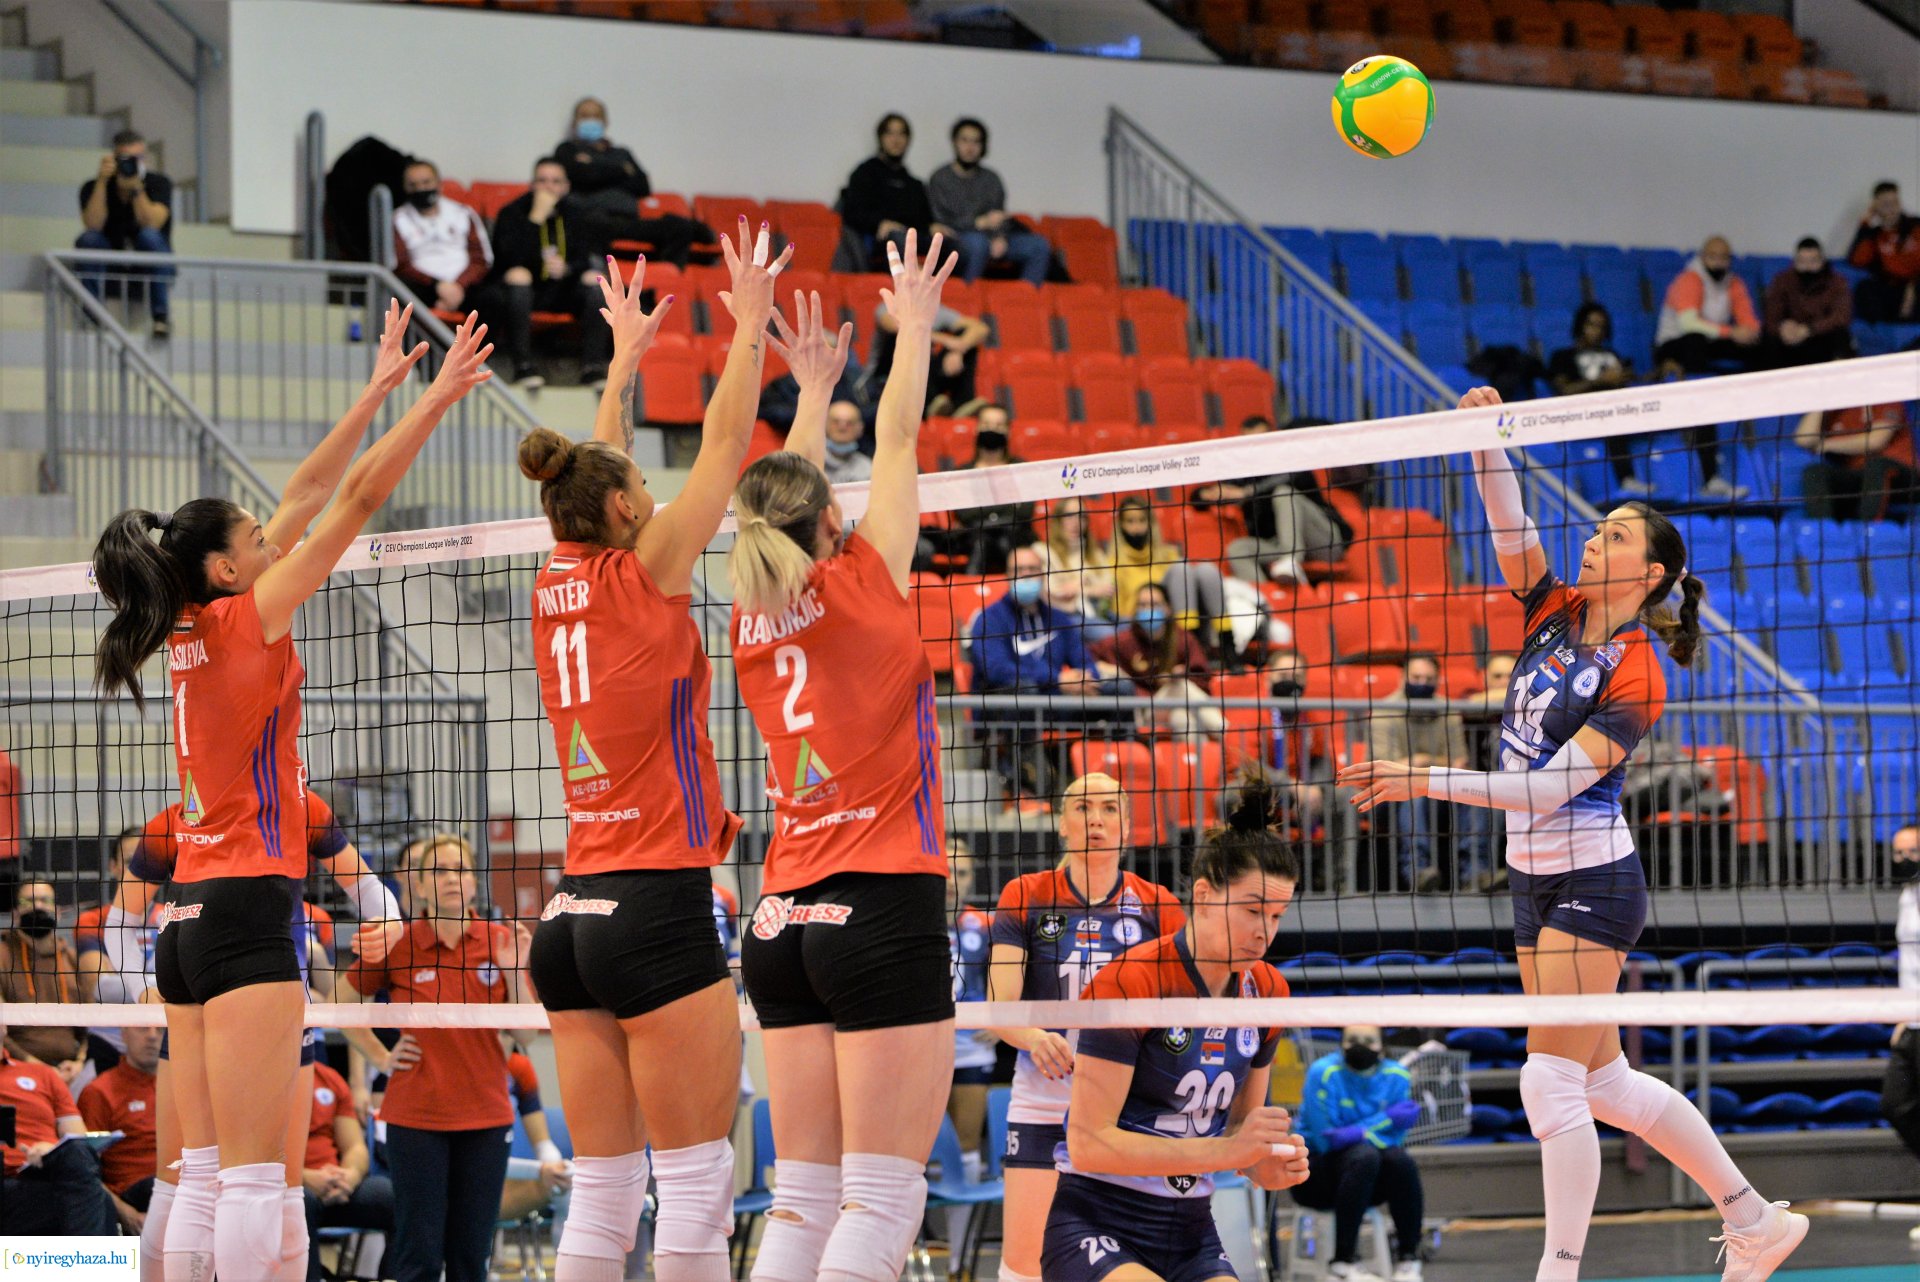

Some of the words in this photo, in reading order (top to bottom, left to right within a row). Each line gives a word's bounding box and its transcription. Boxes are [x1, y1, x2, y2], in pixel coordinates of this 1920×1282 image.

[1521, 416, 1538, 428] CEV
[1539, 411, 1583, 427] Champions
[1585, 408, 1614, 422] League
[1616, 404, 1640, 418] Volley
[1641, 401, 1661, 413] 2022
[1082, 468, 1097, 479] CEV
[1098, 464, 1135, 478] Champions
[1136, 463, 1161, 475] League
[1162, 458, 1183, 471] Volley
[1184, 456, 1201, 468] 2022
[385, 542, 397, 553] CEV
[397, 541, 424, 552] Champions
[424, 540, 444, 551] League
[444, 538, 460, 548] Volley
[460, 535, 473, 546] 2022
[536, 577, 590, 618] PINTÉR
[169, 639, 209, 671] ASILEVA
[551, 620, 591, 708] 11
[774, 644, 815, 733] 2
[175, 681, 190, 757] 1
[599, 778, 610, 791] 21
[1154, 1069, 1236, 1135] 20
[1079, 1235, 1121, 1266] 20
